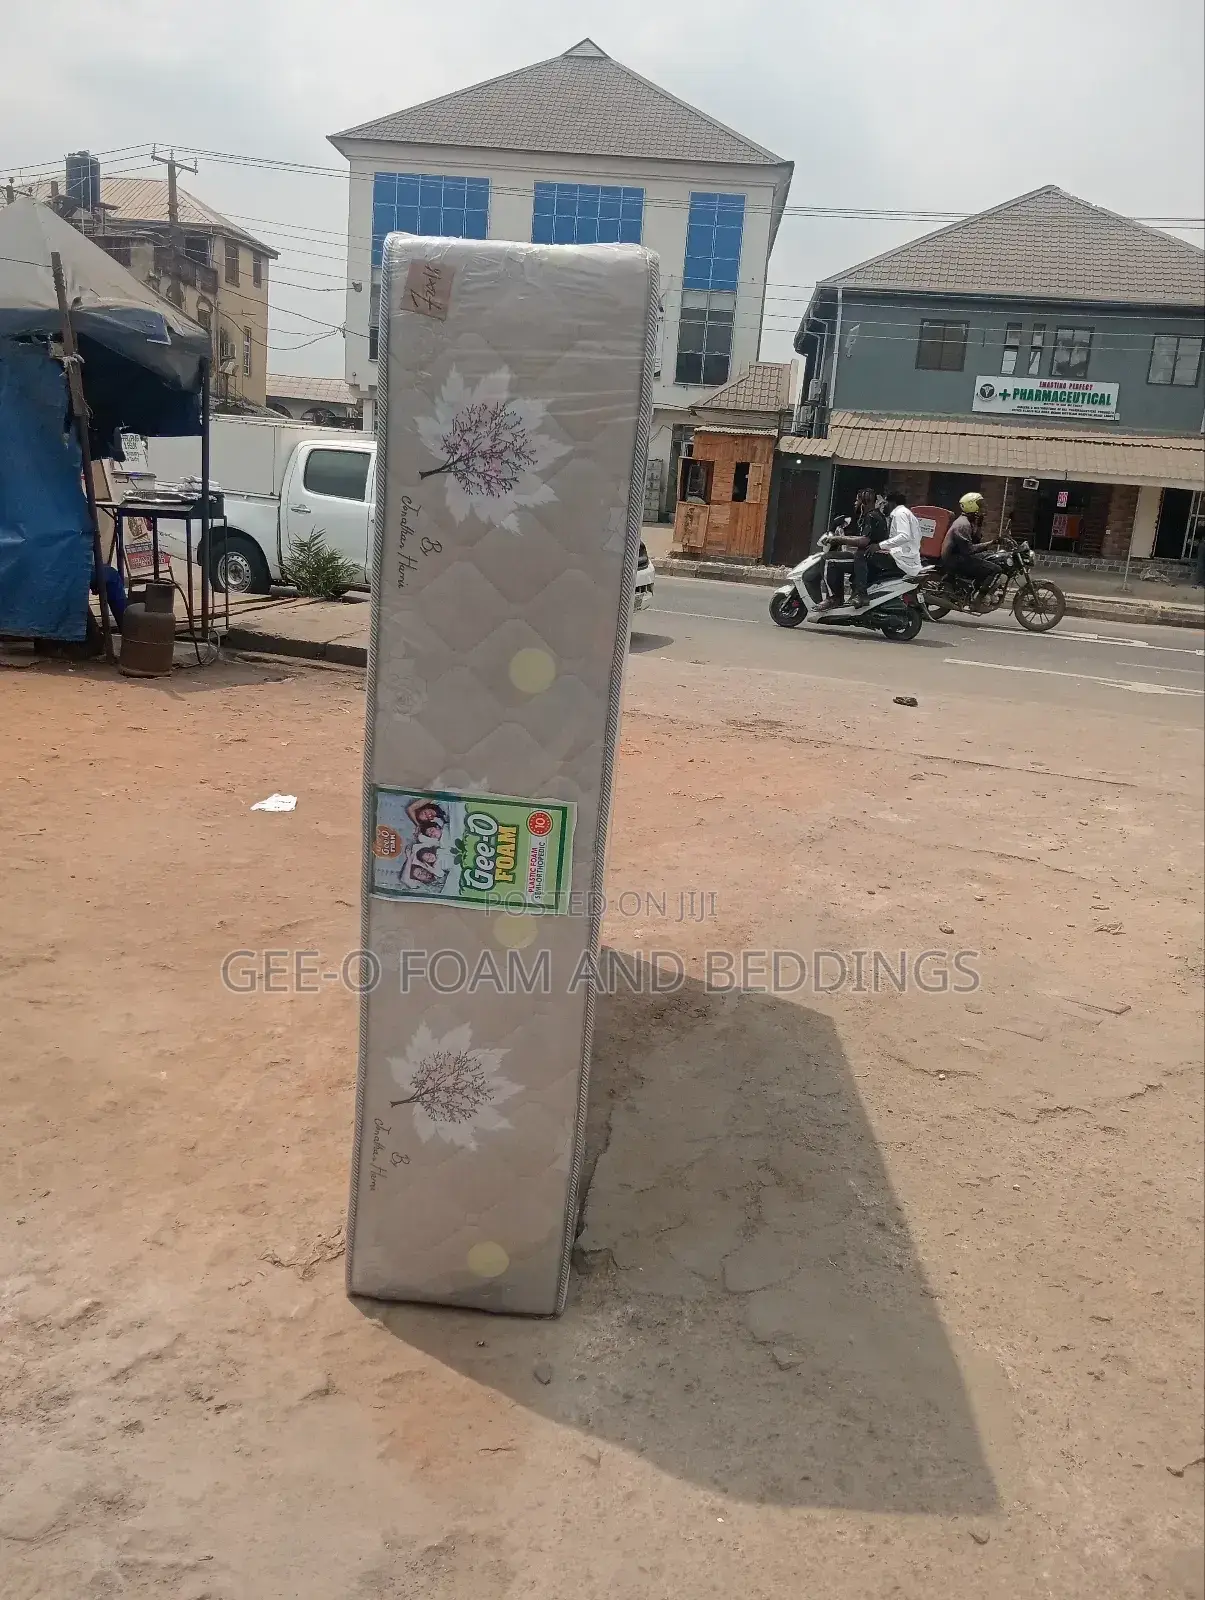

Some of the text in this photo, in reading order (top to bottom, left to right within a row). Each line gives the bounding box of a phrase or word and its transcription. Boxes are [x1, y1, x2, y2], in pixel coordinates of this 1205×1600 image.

[1012, 388, 1111, 405] PHARMACEUTICAL
[1069, 383, 1094, 391] PERFECT
[399, 495, 422, 549] Jonathan
[420, 536, 443, 557] By
[535, 817, 546, 829] 10
[463, 812, 499, 890] Gee-O
[495, 825, 517, 883] FOAM
[528, 847, 538, 893] PLASTIC FOAM
[534, 841, 546, 899] SEMI-ORTHOPEDIC
